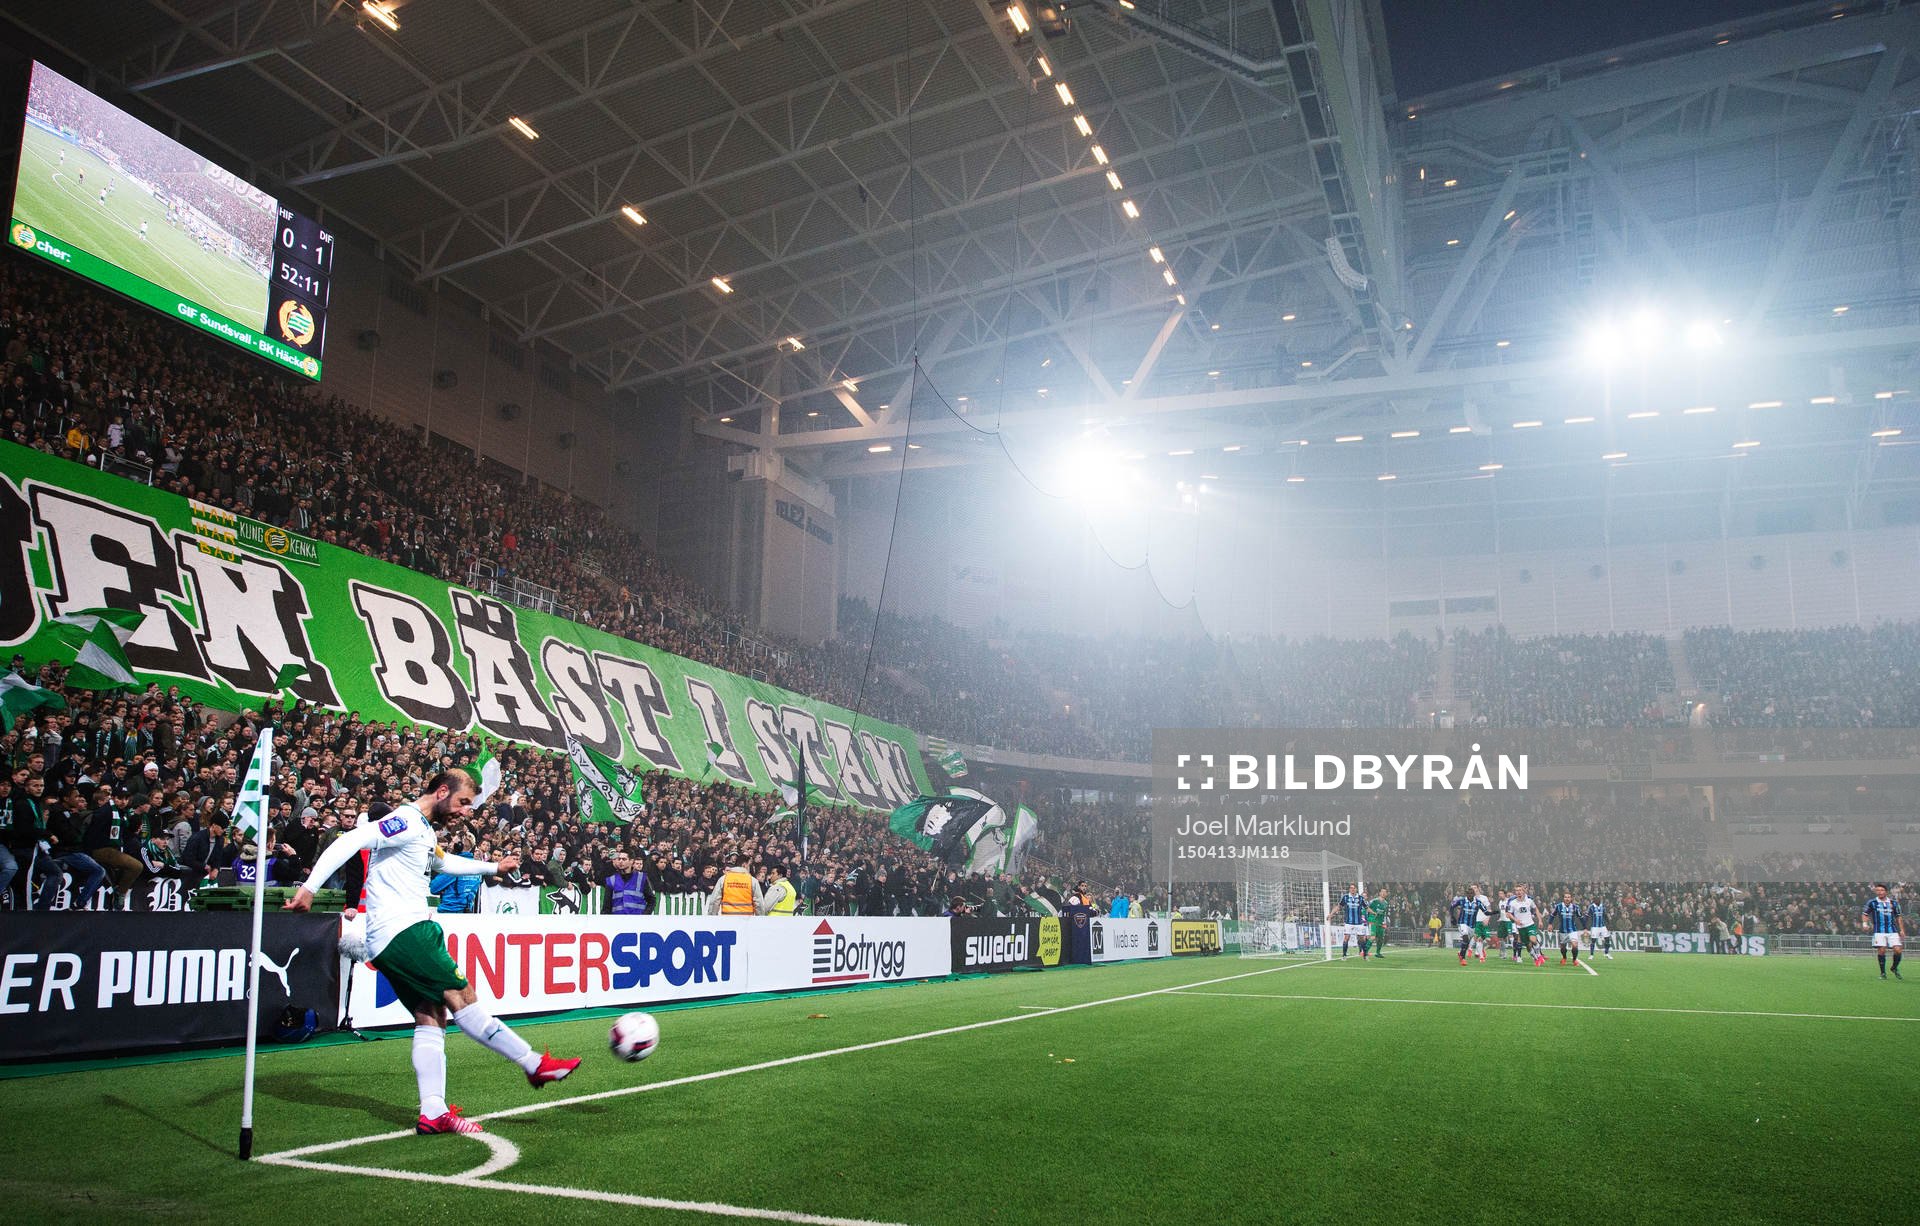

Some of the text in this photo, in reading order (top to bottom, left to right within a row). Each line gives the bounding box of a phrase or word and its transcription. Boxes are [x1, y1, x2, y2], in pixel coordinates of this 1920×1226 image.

[280, 206, 294, 220] HIF
[36, 241, 71, 262] cher:
[282, 228, 294, 248] 0
[316, 247, 322, 265] 1
[320, 230, 334, 244] DIF
[281, 262, 319, 296] 52:11
[178, 303, 198, 319] GIF
[200, 313, 252, 345] Sundsvall
[259, 340, 274, 356] BK
[193, 502, 235, 527] HAM
[196, 521, 236, 545] MAR
[240, 522, 317, 558] KUNG KENKA
[200, 541, 235, 561] BAJ
[349, 578, 684, 772] BÄST
[684, 675, 756, 786] I
[240, 865, 256, 880] 32
[834, 933, 905, 979] Botrygg
[965, 923, 1029, 966] swedol
[97, 948, 246, 1009] PUMA
